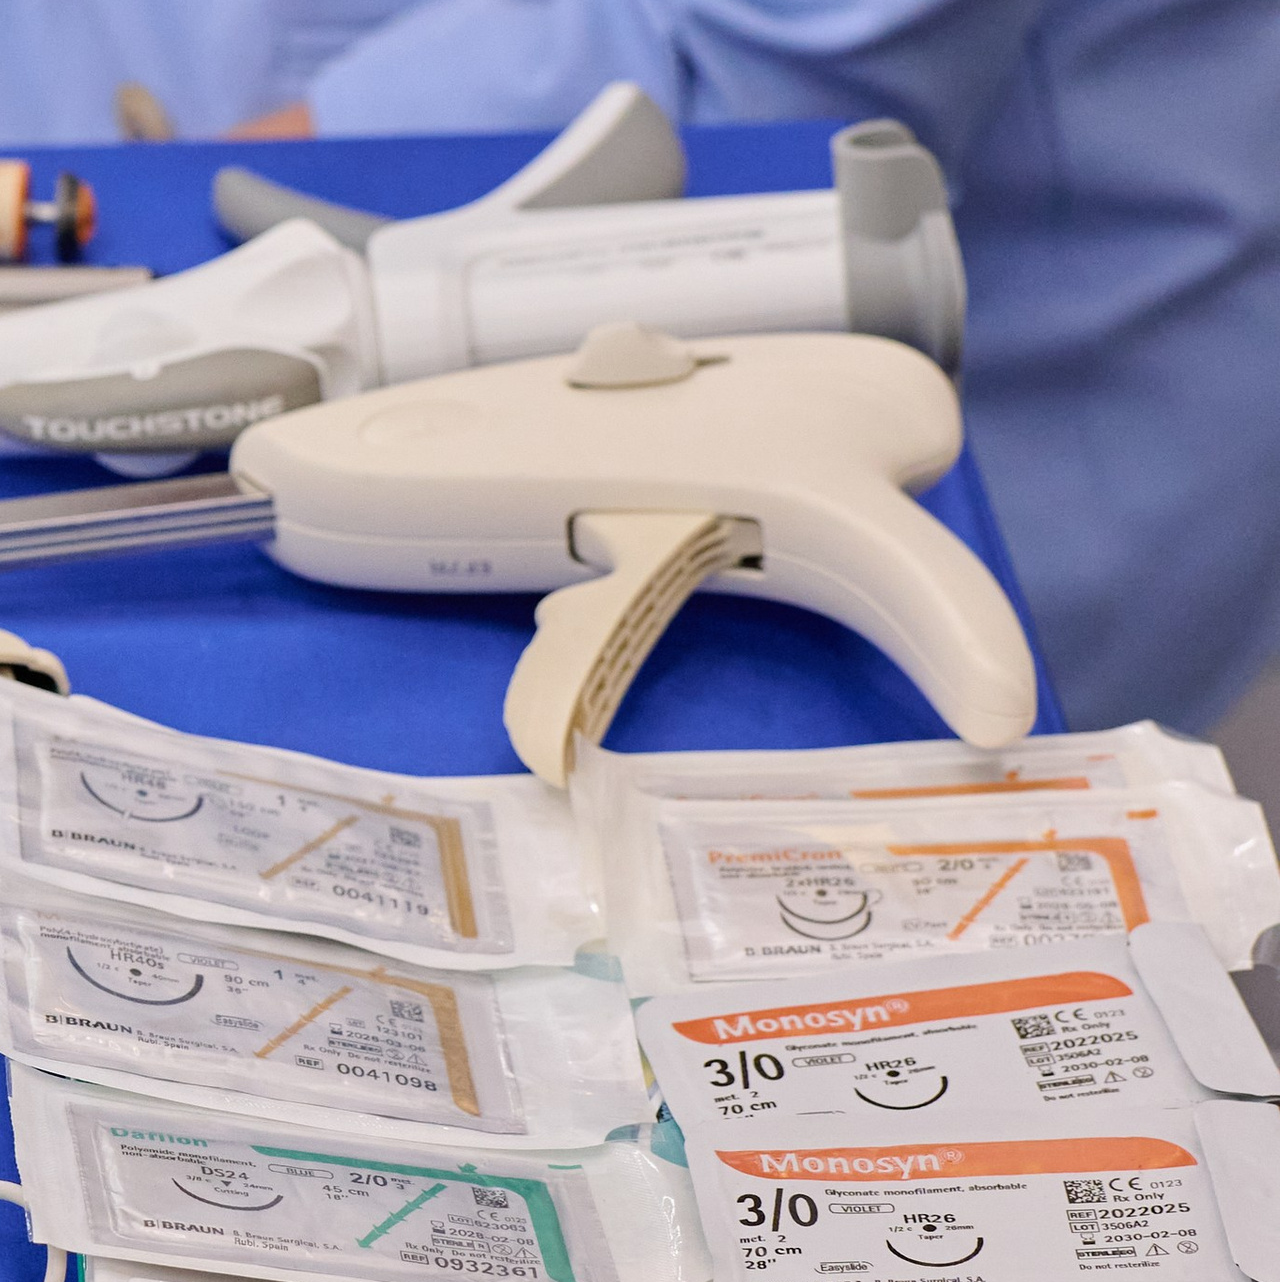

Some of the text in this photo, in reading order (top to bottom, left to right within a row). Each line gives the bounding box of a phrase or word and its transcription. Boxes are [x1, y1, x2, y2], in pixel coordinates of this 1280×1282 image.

[332, 885, 429, 916] 0041119
[224, 974, 270, 988] 90 cm
[1062, 1021, 1111, 1033] Rx Only
[1050, 1030, 1139, 1051] 2022025
[320, 1046, 341, 1057] Only
[1057, 1048, 1102, 1062] 3506A2
[703, 1050, 785, 1090] 3/0
[865, 1057, 917, 1072] HR26
[1062, 1054, 1150, 1073] 2030-02-08
[337, 1063, 437, 1092] 0041098
[718, 1099, 777, 1116] 70 cm
[120, 1144, 257, 1167] Polyamide monofilament,
[122, 1151, 207, 1166] non-absorbable
[201, 1166, 250, 1181] DS24
[287, 1167, 315, 1177] BLUE
[243, 1182, 273, 1191] 24mm
[350, 1172, 388, 1187] 2/0
[1150, 1179, 1182, 1189] 0123
[214, 1186, 250, 1197] Cutting
[322, 1184, 370, 1198] 45 cm
[825, 1182, 1027, 1197] Glyconate monofilament, absorbable
[1134, 1192, 1165, 1202] Only
[736, 1187, 819, 1232] 3/0
[841, 1205, 882, 1213] VIOLET
[1098, 1202, 1191, 1219] 2022025
[903, 1214, 956, 1224] HR26
[1102, 1220, 1149, 1231] 3506A2
[245, 1232, 274, 1242] Braun
[449, 1227, 535, 1246] 2028-02-08
[739, 1235, 787, 1244] met. 2
[1104, 1229, 1197, 1243] 2030-02-08
[262, 1241, 289, 1252] Spain
[405, 1242, 541, 1265] Rx Only Do not resterilize
[742, 1245, 803, 1257] 70 cm
[435, 1257, 538, 1279] 0932361
[820, 1262, 868, 1273] Easyslide
[1079, 1260, 1161, 1271] Do not resterilize
